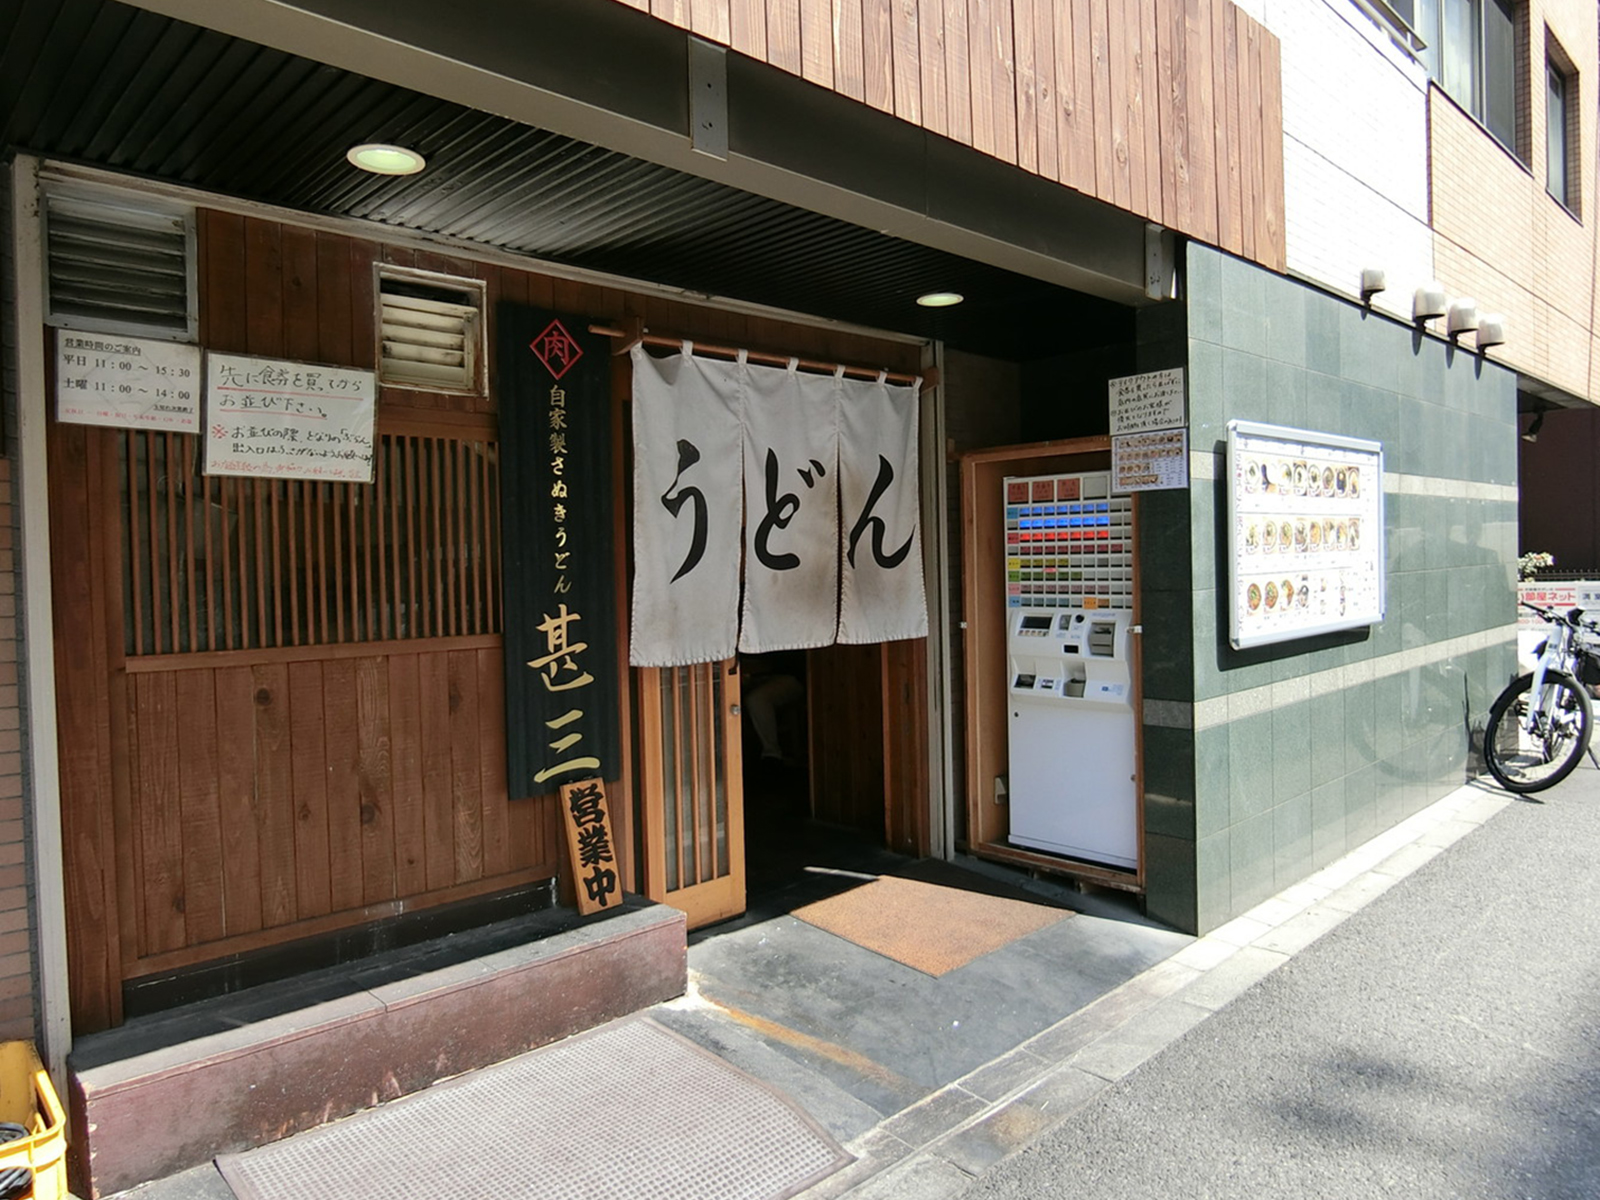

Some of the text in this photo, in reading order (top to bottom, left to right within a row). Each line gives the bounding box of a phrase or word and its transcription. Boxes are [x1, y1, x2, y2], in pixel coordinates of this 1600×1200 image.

[65, 338, 141, 355] 営業時間のご案内
[544, 330, 569, 365] 肉
[63, 354, 87, 366] 平日
[95, 358, 132, 371] 11:00
[155, 365, 191, 378] 15:30
[220, 364, 363, 391] 先に食券を買ってから
[64, 378, 88, 390] 土曜
[95, 381, 132, 393] 11:00
[155, 388, 191, 400] 14:00
[219, 394, 327, 417] お並び下さい。
[549, 384, 572, 594] 自家製さぬきうどん
[661, 438, 917, 585] うどん
[526, 604, 601, 783] 甚三
[569, 783, 617, 907] 営業中
